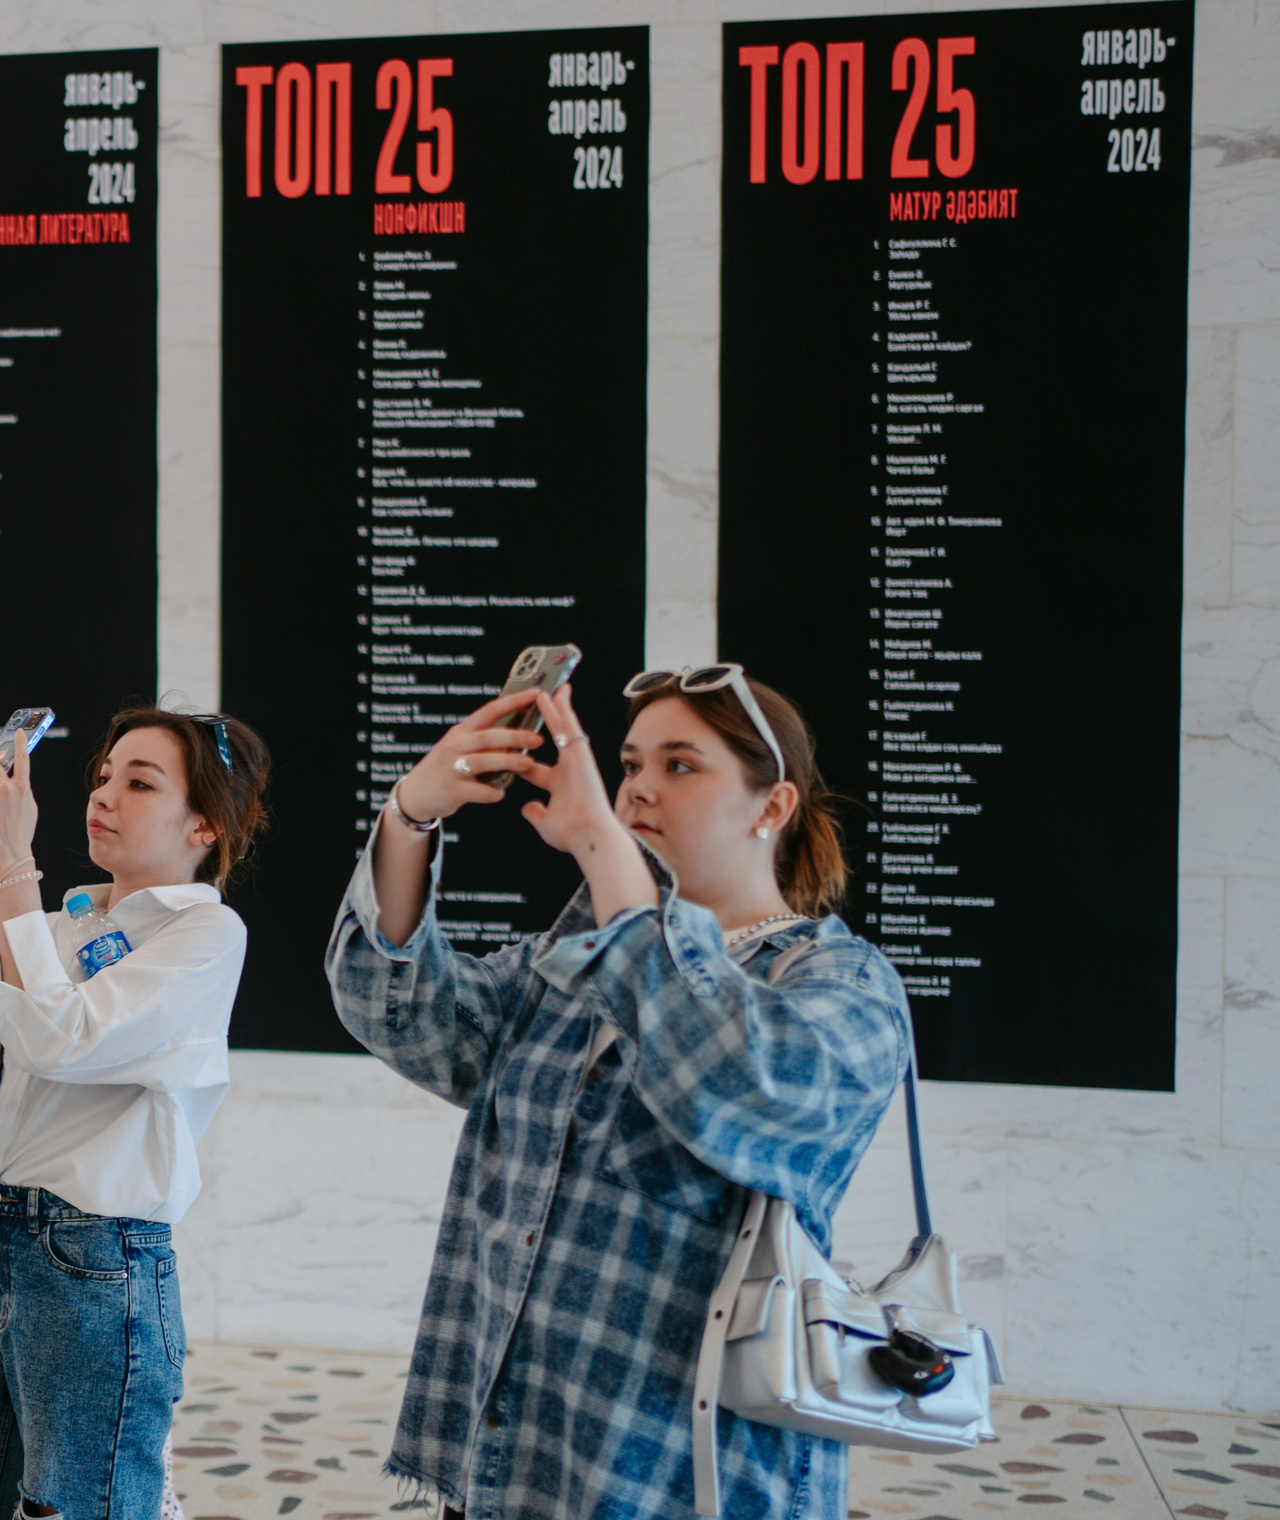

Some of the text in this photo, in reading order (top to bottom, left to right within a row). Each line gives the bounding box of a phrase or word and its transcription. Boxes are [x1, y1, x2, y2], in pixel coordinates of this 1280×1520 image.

[1081, 28, 1176, 69] январь-
[63, 71, 146, 110] январь-
[548, 51, 635, 91] январь-
[548, 98, 627, 139] апрель
[739, 36, 976, 184] ТОП 25
[1081, 77, 1165, 120] апрель
[63, 117, 139, 156] апрель
[235, 58, 454, 198] ТОП 25
[574, 145, 623, 190] 2024
[1107, 127, 1162, 173] 2024
[88, 162, 136, 204] 2024
[373, 201, 466, 235] НОНФИКШН
[889, 188, 1018, 225] МАТУР ӘДӘБИЯТ
[39, 212, 131, 245] ЛИТЕРАТУРА
